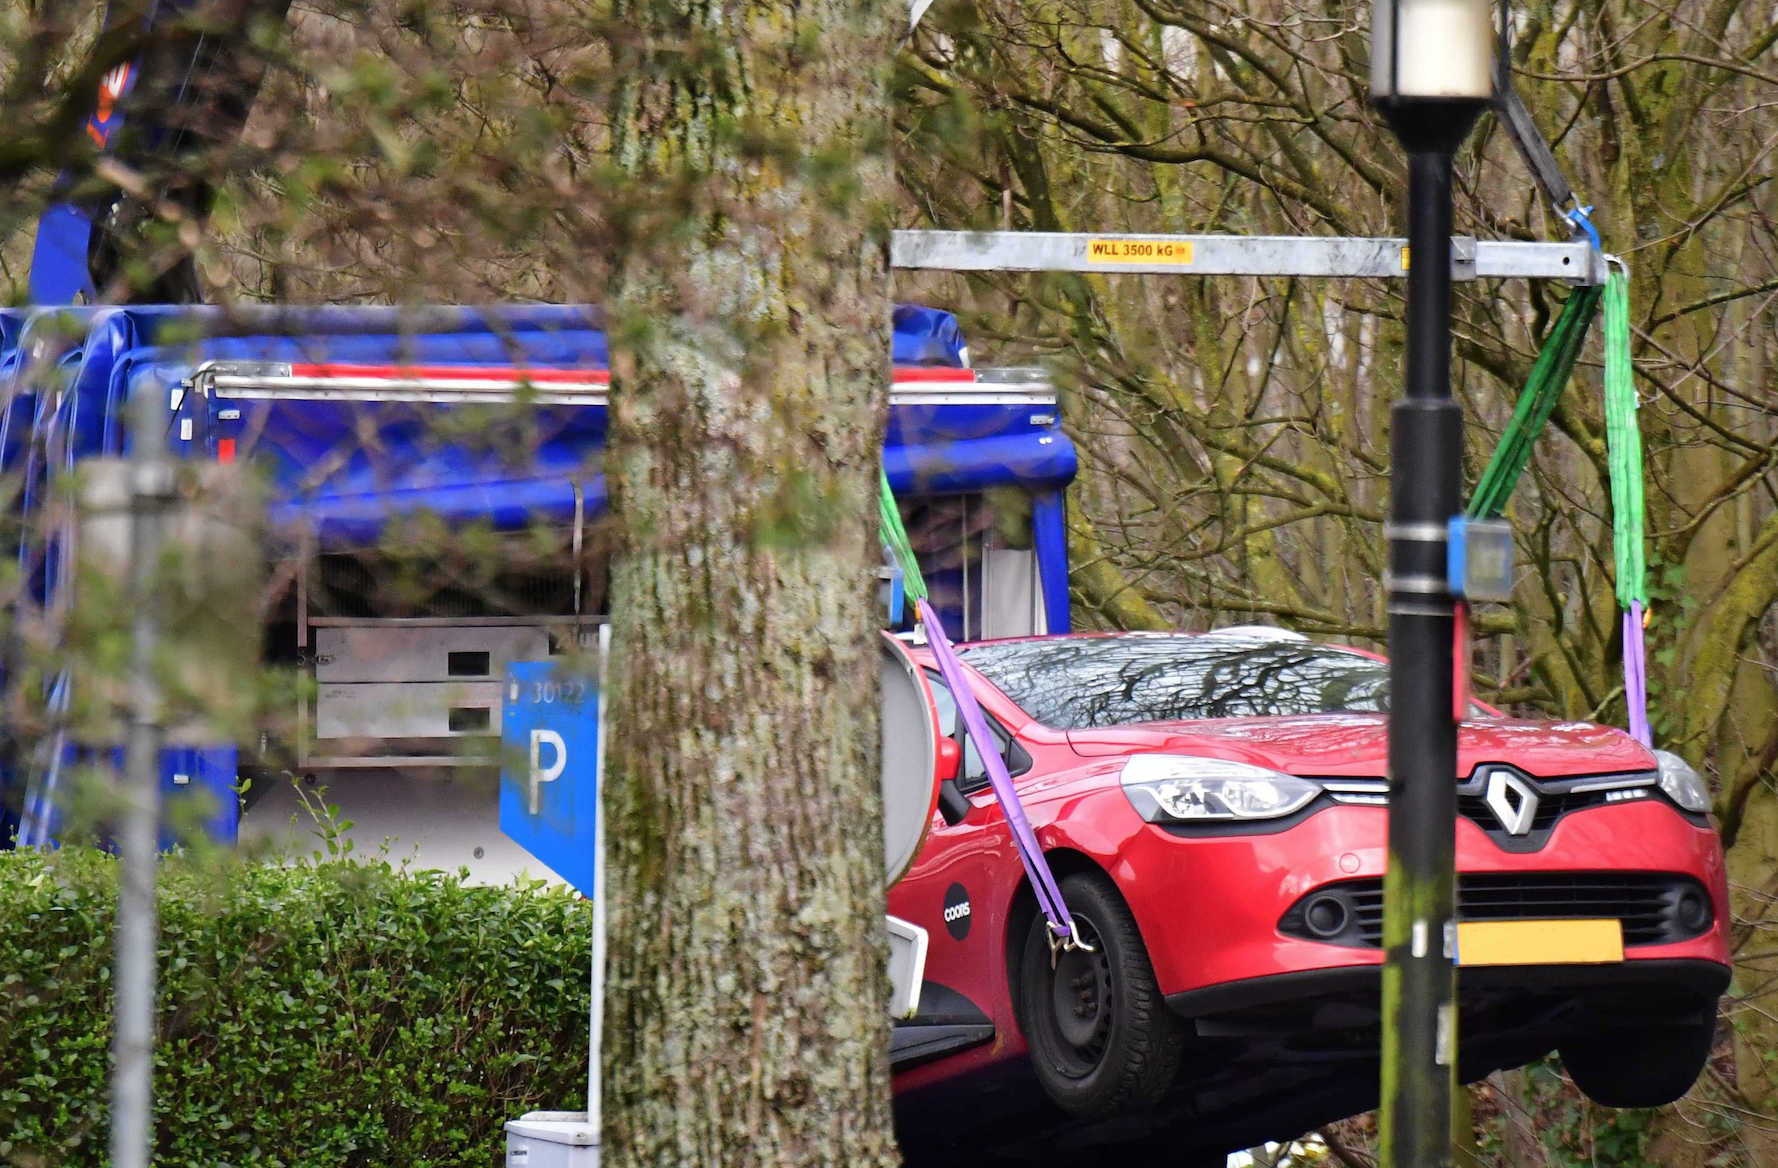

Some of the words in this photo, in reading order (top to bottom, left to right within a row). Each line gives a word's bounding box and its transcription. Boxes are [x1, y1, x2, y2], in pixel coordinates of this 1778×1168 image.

[1092, 244, 1119, 255] WLL
[1123, 244, 1152, 256] 3500
[529, 729, 567, 815] P
